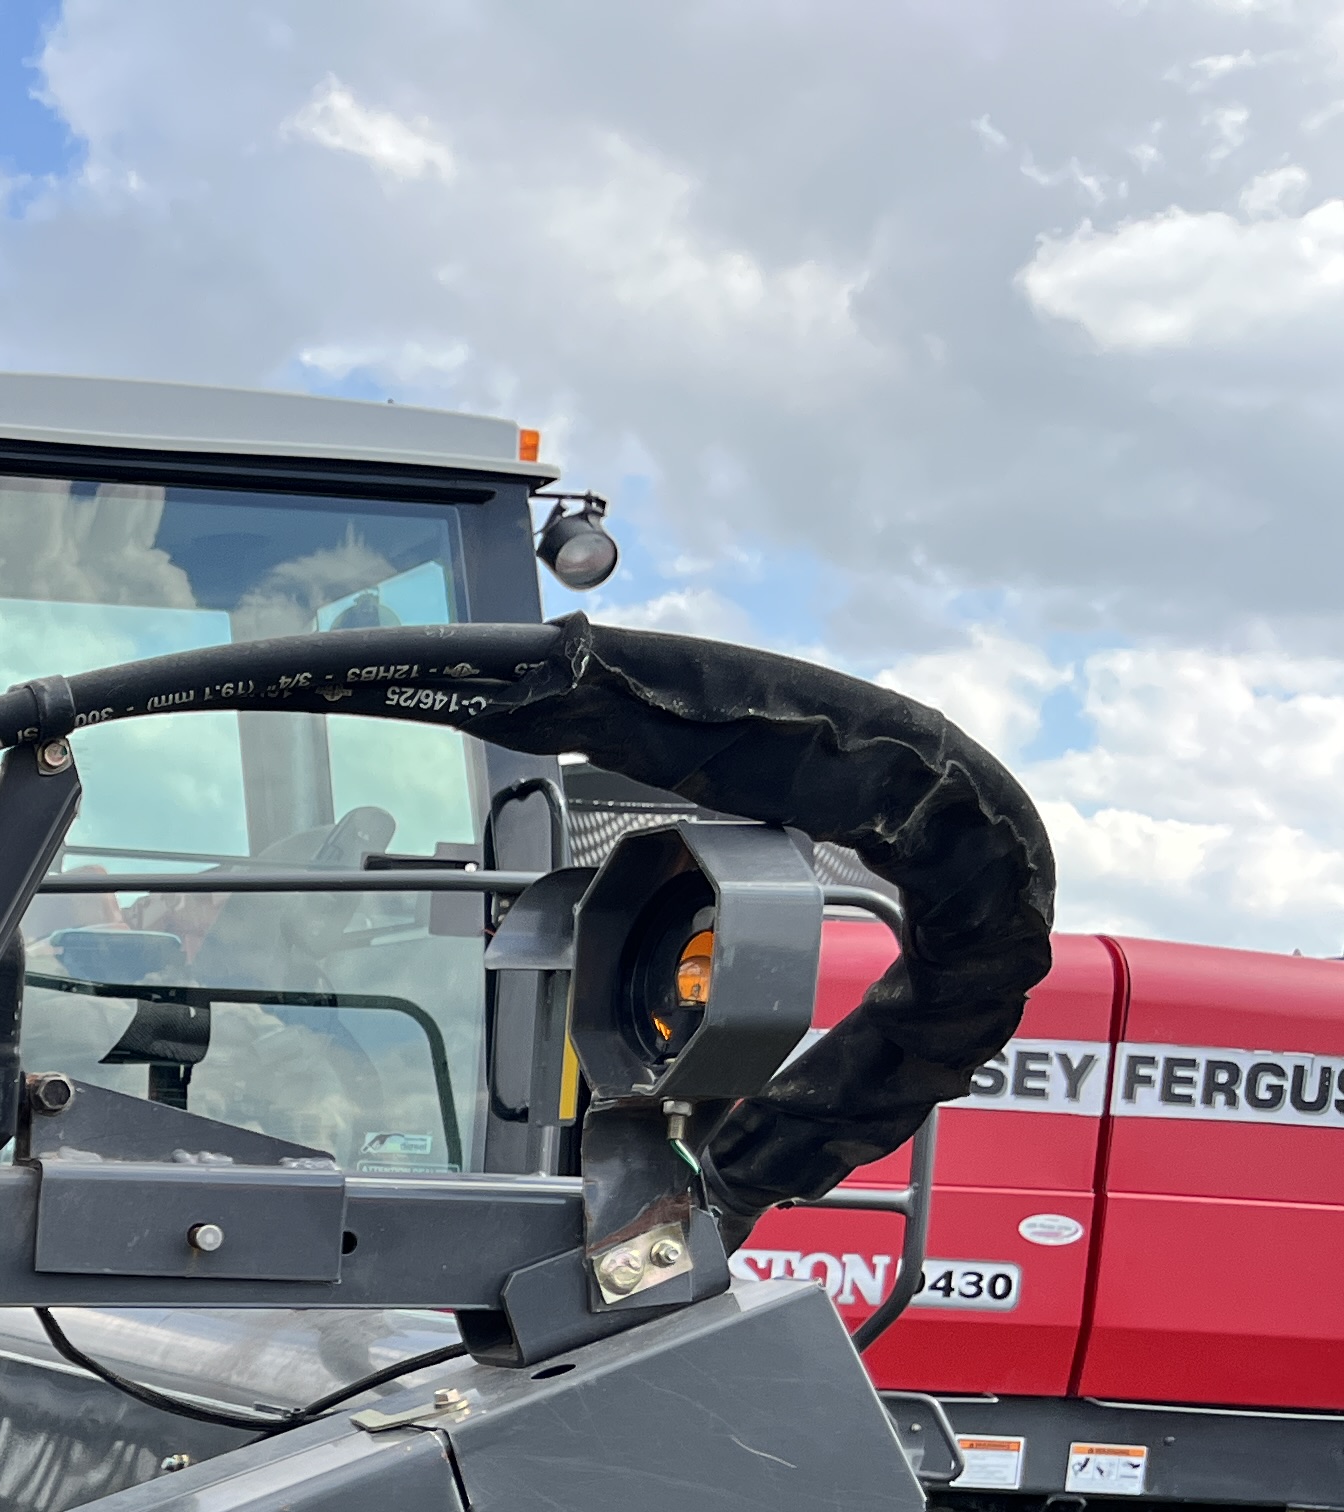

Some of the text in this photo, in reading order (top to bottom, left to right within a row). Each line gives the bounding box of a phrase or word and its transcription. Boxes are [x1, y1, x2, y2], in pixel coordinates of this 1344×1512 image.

[347, 663, 420, 683] 12HB3
[1121, 1054, 1344, 1115] FERGU
[912, 1270, 1013, 1300] 430
